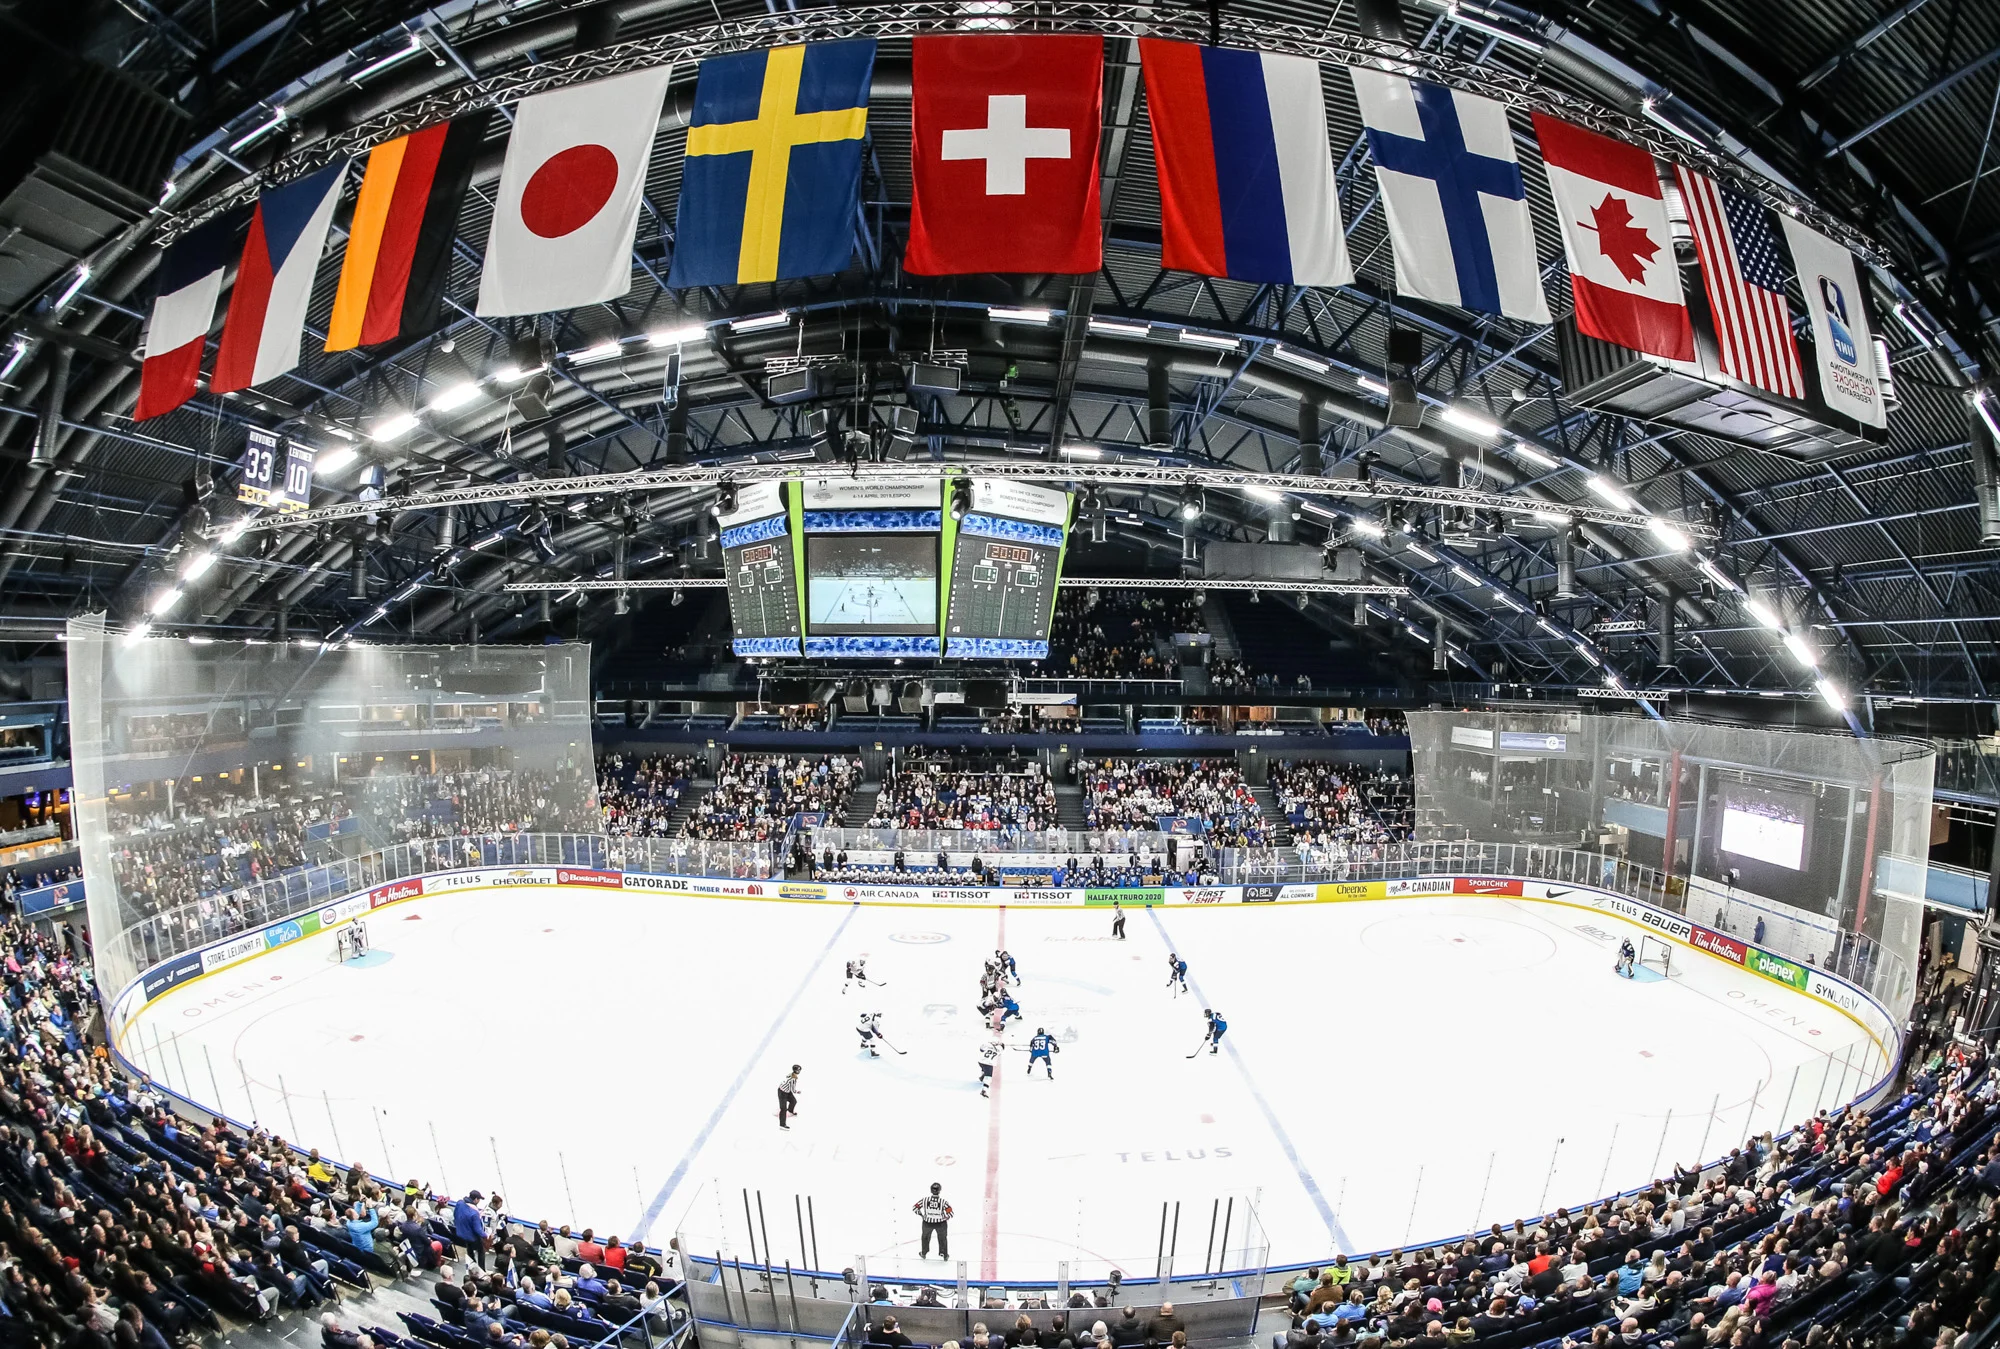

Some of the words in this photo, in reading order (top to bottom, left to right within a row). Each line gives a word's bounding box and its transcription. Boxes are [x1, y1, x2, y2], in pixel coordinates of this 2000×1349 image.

[245, 448, 272, 482] 33
[288, 462, 308, 495] 10
[744, 548, 768, 562] 20:00
[992, 546, 1028, 561] 20:00
[446, 875, 482, 886] TELUS
[492, 876, 552, 886] CHEVROLET
[624, 876, 688, 890] GATORADE
[1412, 880, 1451, 892] CANADIAN
[693, 884, 720, 893] TIMBER
[722, 886, 744, 894] MART
[860, 890, 876, 898] AIR
[878, 890, 920, 899] CANADA
[949, 890, 990, 899] TISSOT
[1336, 884, 1368, 895] Cheerios
[372, 890, 387, 906] Tim
[387, 886, 418, 902] Hortons
[1031, 892, 1072, 900] TISSOT
[348, 900, 368, 913] Synergy
[1610, 900, 1637, 916] TELUS
[1694, 930, 1710, 950] Tim
[1708, 938, 1742, 963] Hortons
[1758, 956, 1795, 983] planex
[183, 980, 264, 1017] OMEN
[1727, 990, 1804, 1029] OMEN
[1034, 1040, 1046, 1050] 33
[984, 1049, 998, 1061] 27
[1115, 1146, 1232, 1163] TELUS
[666, 1256, 674, 1268] 4
